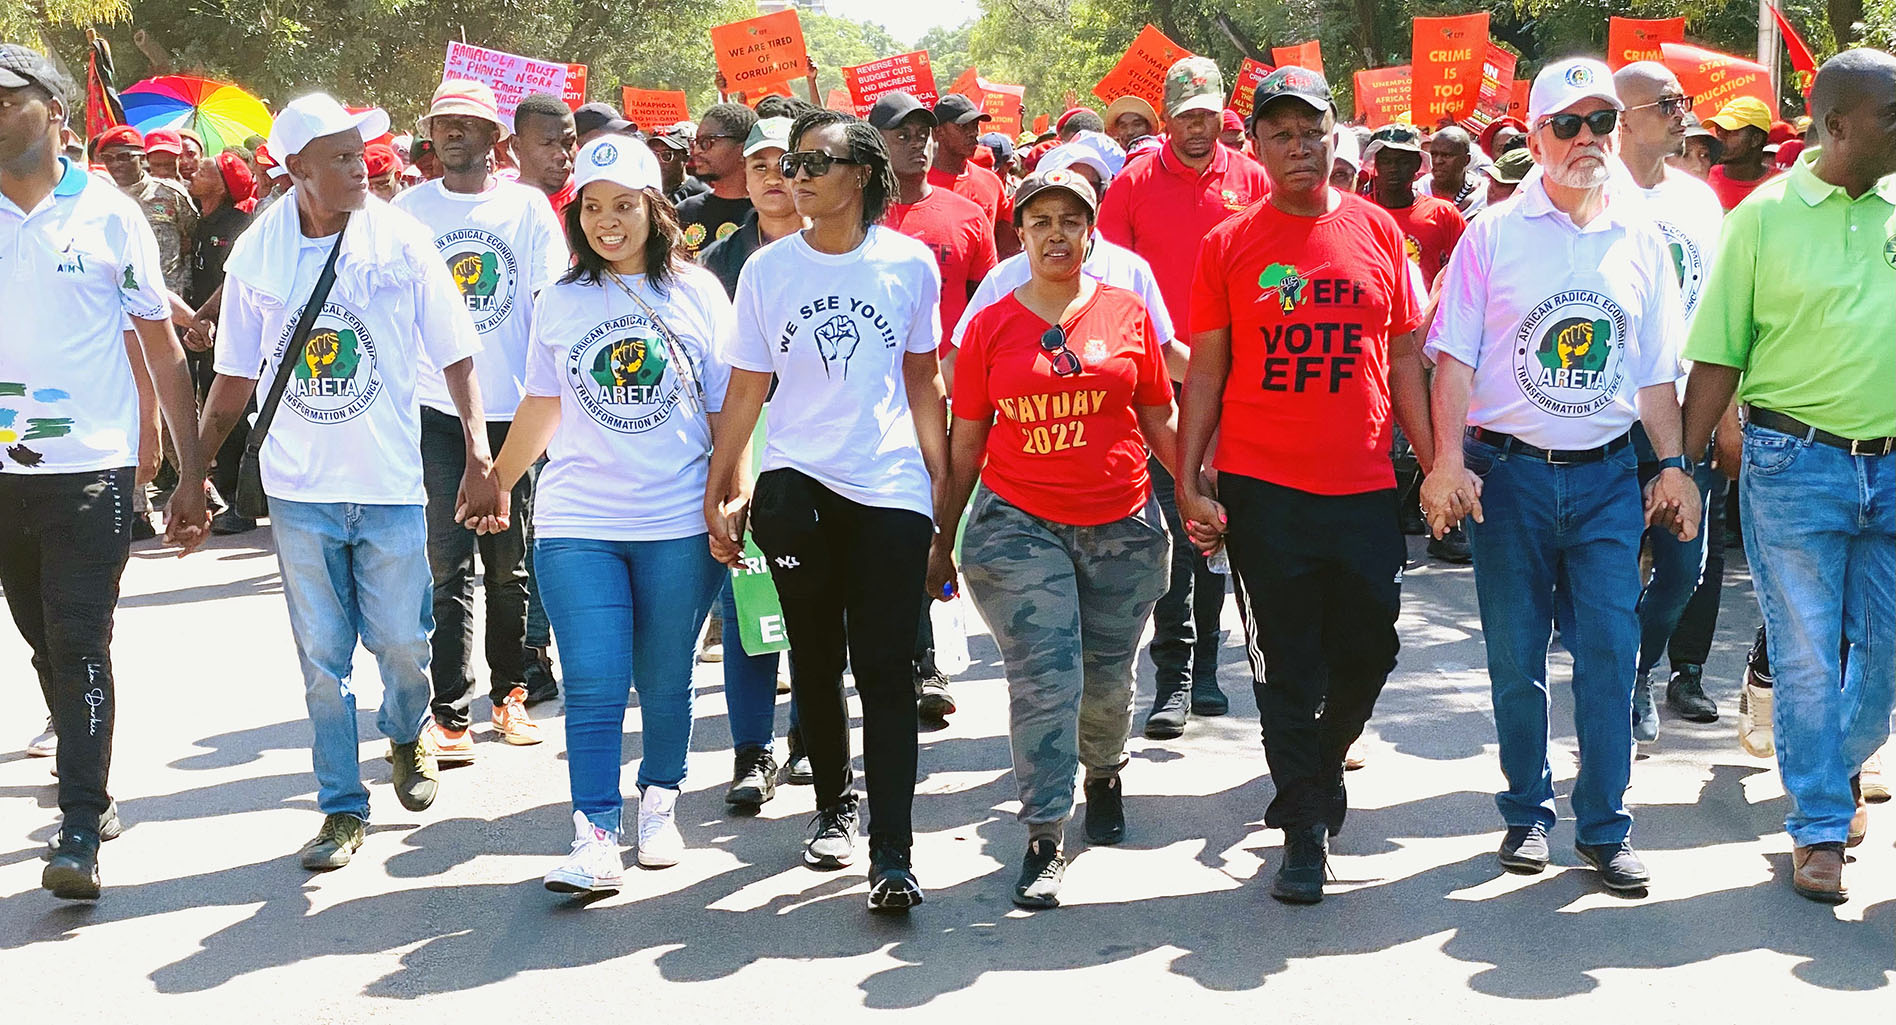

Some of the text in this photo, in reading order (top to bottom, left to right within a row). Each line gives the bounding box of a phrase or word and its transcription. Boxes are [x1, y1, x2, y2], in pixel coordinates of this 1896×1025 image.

[728, 36, 793, 58] WE ARE TIRED
[1430, 49, 1471, 62] CRIME
[757, 54, 770, 63] OF
[856, 56, 910, 75] REVERSE THE
[1136, 48, 1168, 72] RAMAP
[525, 62, 559, 78] MUST
[735, 59, 798, 81] CORRUPION
[857, 65, 913, 84] BUDGET CUTS
[1444, 67, 1457, 79] IS
[1710, 69, 1727, 83] OF
[860, 75, 917, 93] AND INCREASE
[1127, 69, 1163, 94] STUFFED
[1372, 78, 1412, 88] UNEMPLO
[1433, 84, 1463, 97] TOO
[1375, 95, 1405, 104] AFRICA
[1381, 104, 1391, 112] BE
[1430, 100, 1464, 114] HIGH
[446, 230, 516, 275] RADICAL ECONOMIC
[57, 264, 75, 273] ATM
[1313, 278, 1368, 304] EFF
[780, 296, 896, 353] WE SEE YOU!!!
[1519, 291, 1625, 349] AFRICAN RADICAL ECONOMIC
[343, 311, 375, 360] ECONOMIC
[570, 328, 604, 362] AFRICAN
[604, 316, 648, 331] RADICAL
[1259, 322, 1363, 355] VOTE
[1261, 356, 1356, 394] EFF
[1537, 367, 1607, 391] ARETA
[295, 377, 361, 397] ARETA
[597, 384, 665, 405] ARETA
[1517, 365, 1591, 414] TRANSFORMATION
[283, 378, 380, 421] ANSFORMATION ALLIANCE
[576, 384, 651, 430] TRANSFORMATION
[1021, 420, 1088, 455] 2022
[759, 614, 788, 644] E
